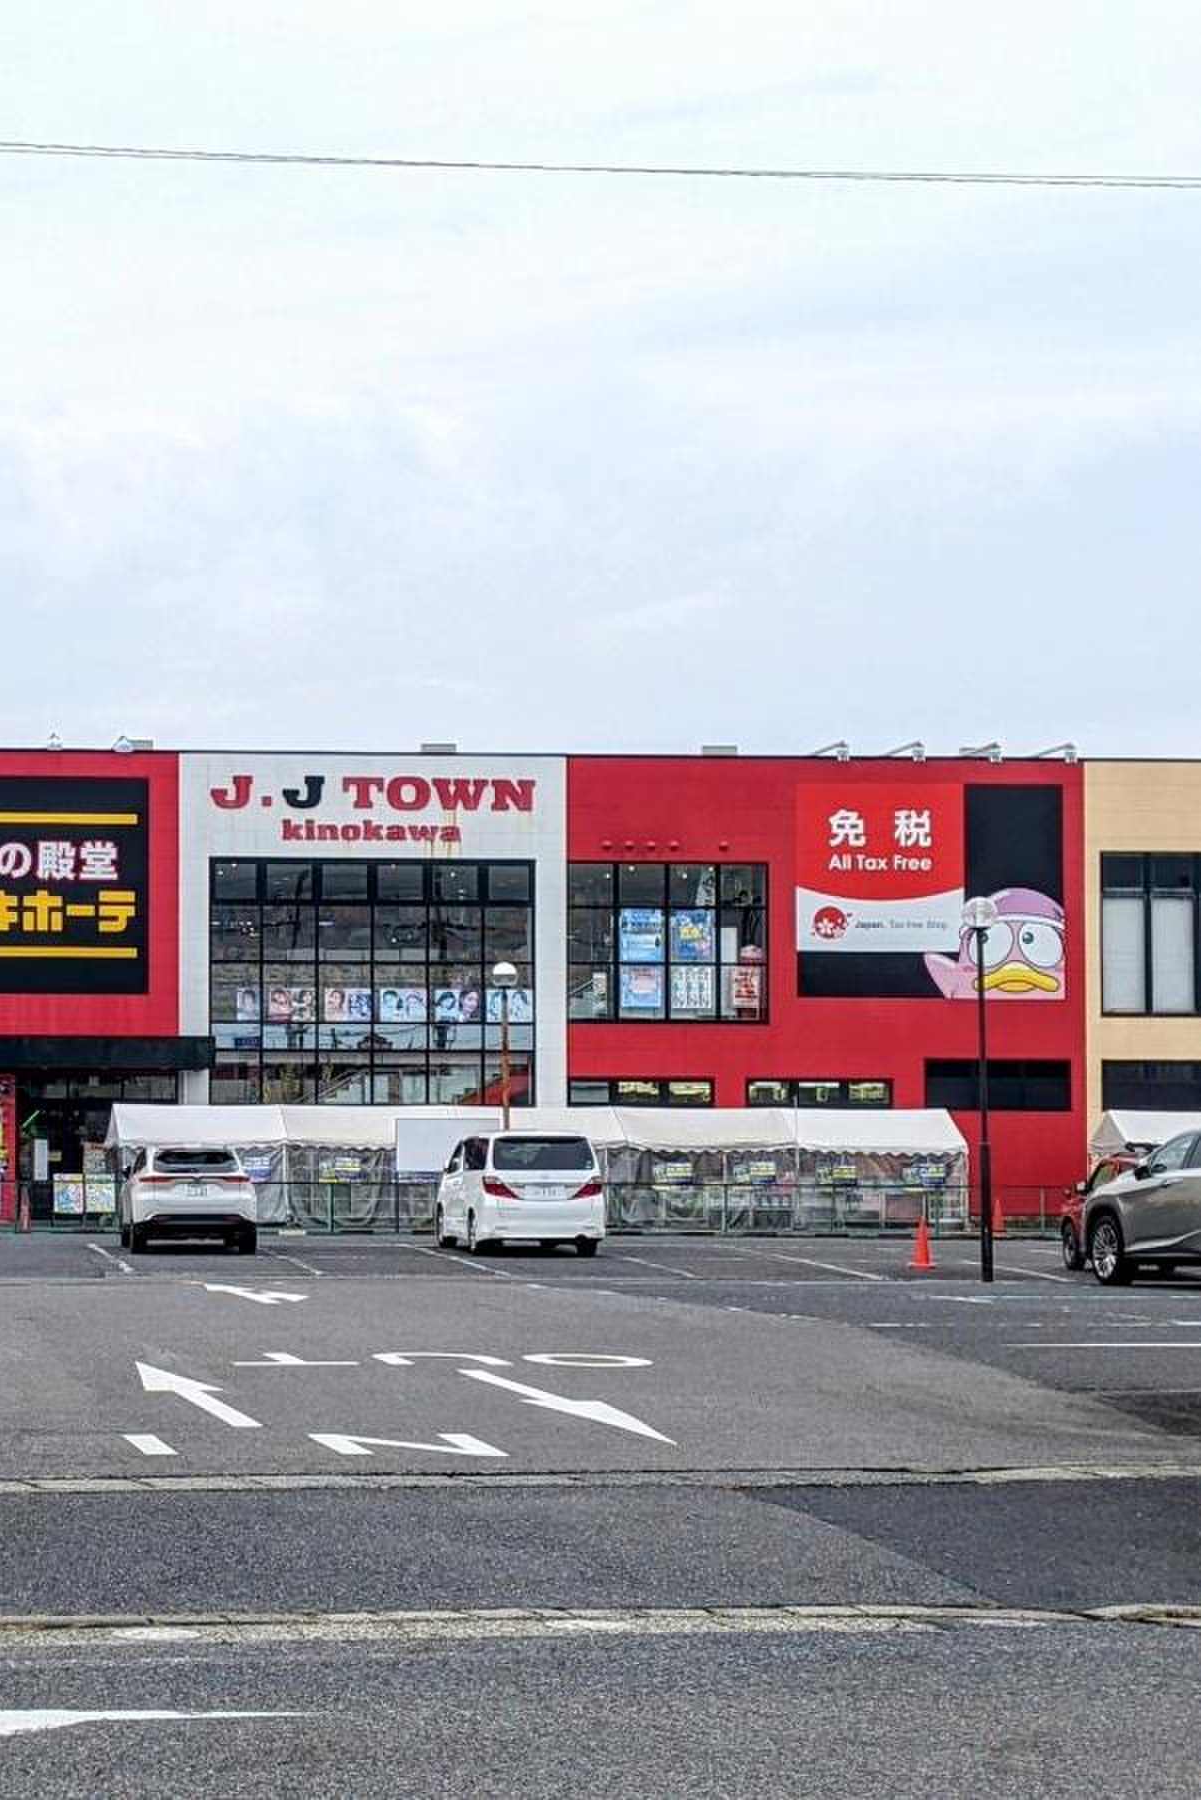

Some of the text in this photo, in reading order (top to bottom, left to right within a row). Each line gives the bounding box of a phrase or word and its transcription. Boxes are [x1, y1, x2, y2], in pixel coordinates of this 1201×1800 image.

[342, 776, 536, 812] TOWN
[282, 819, 461, 842] kinokawa
[828, 854, 932, 871] All Tax Free
